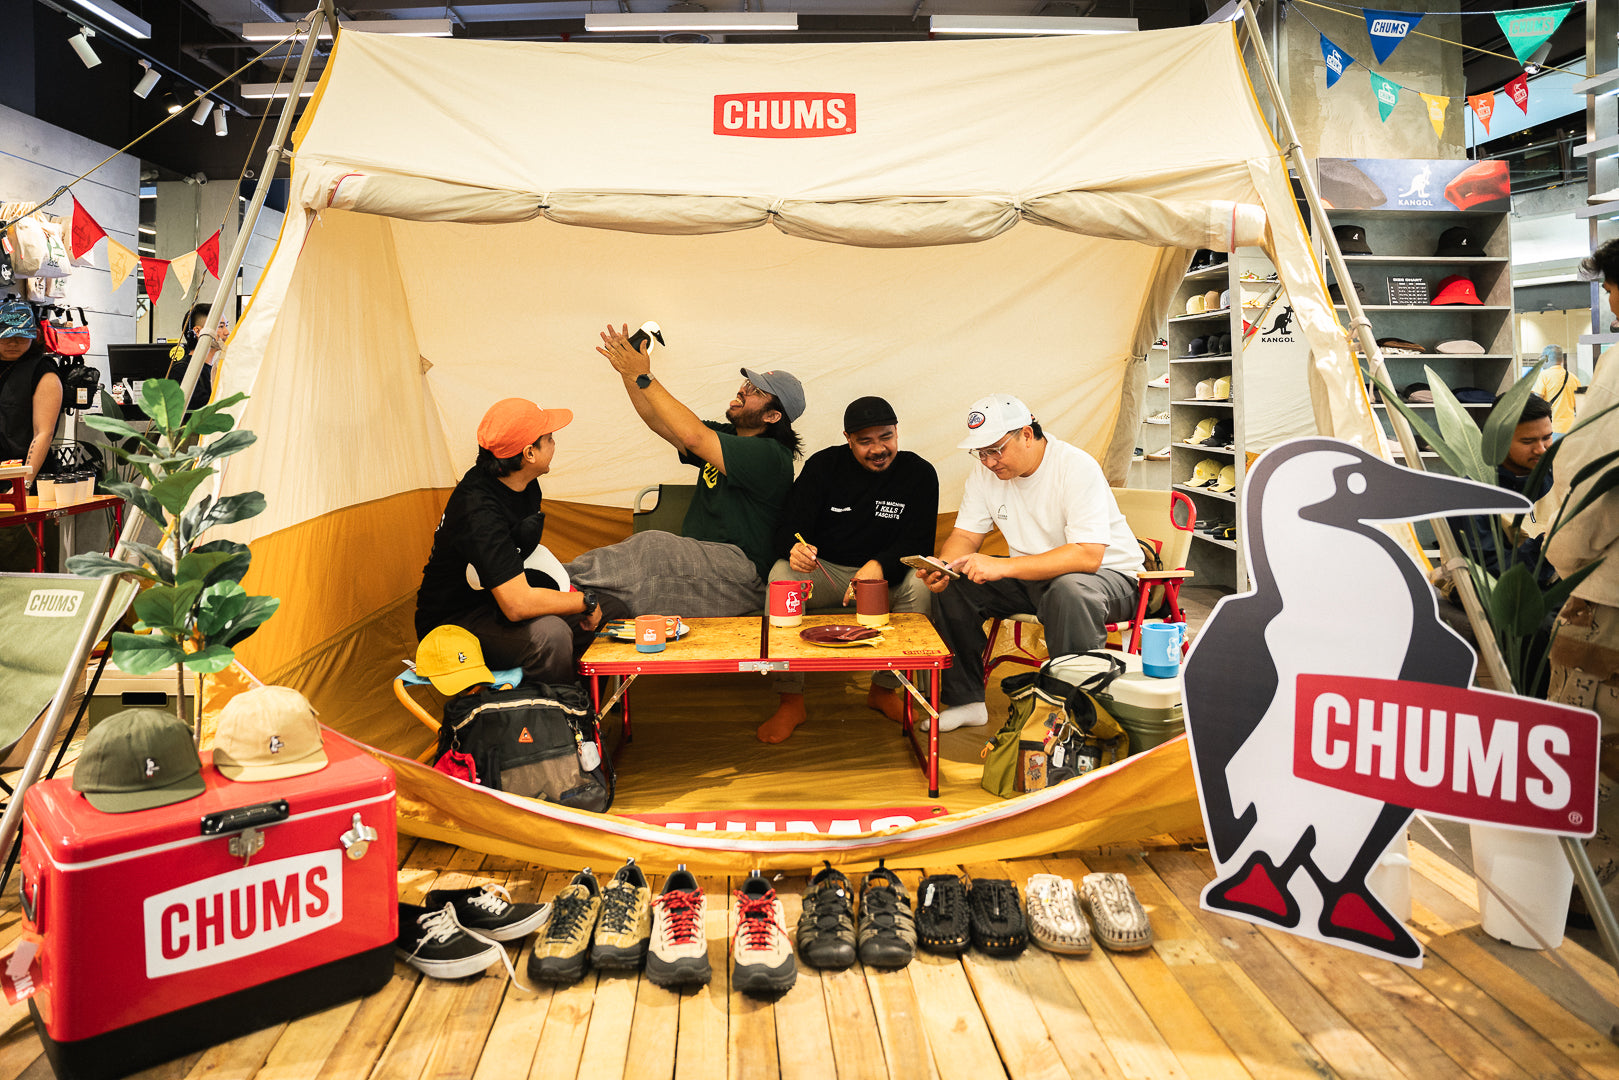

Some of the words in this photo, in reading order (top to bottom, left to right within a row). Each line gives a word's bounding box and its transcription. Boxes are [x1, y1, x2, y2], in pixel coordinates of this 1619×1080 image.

[1373, 21, 1406, 35] CHUMS
[1511, 19, 1551, 34] CHUMS
[722, 98, 847, 130] CHUMS
[875, 511, 900, 520] FASCISTS
[880, 505, 899, 514] KILLS
[29, 594, 78, 612] CHUMS
[1311, 692, 1572, 811] CHUMS
[161, 866, 330, 960] CHUMS
